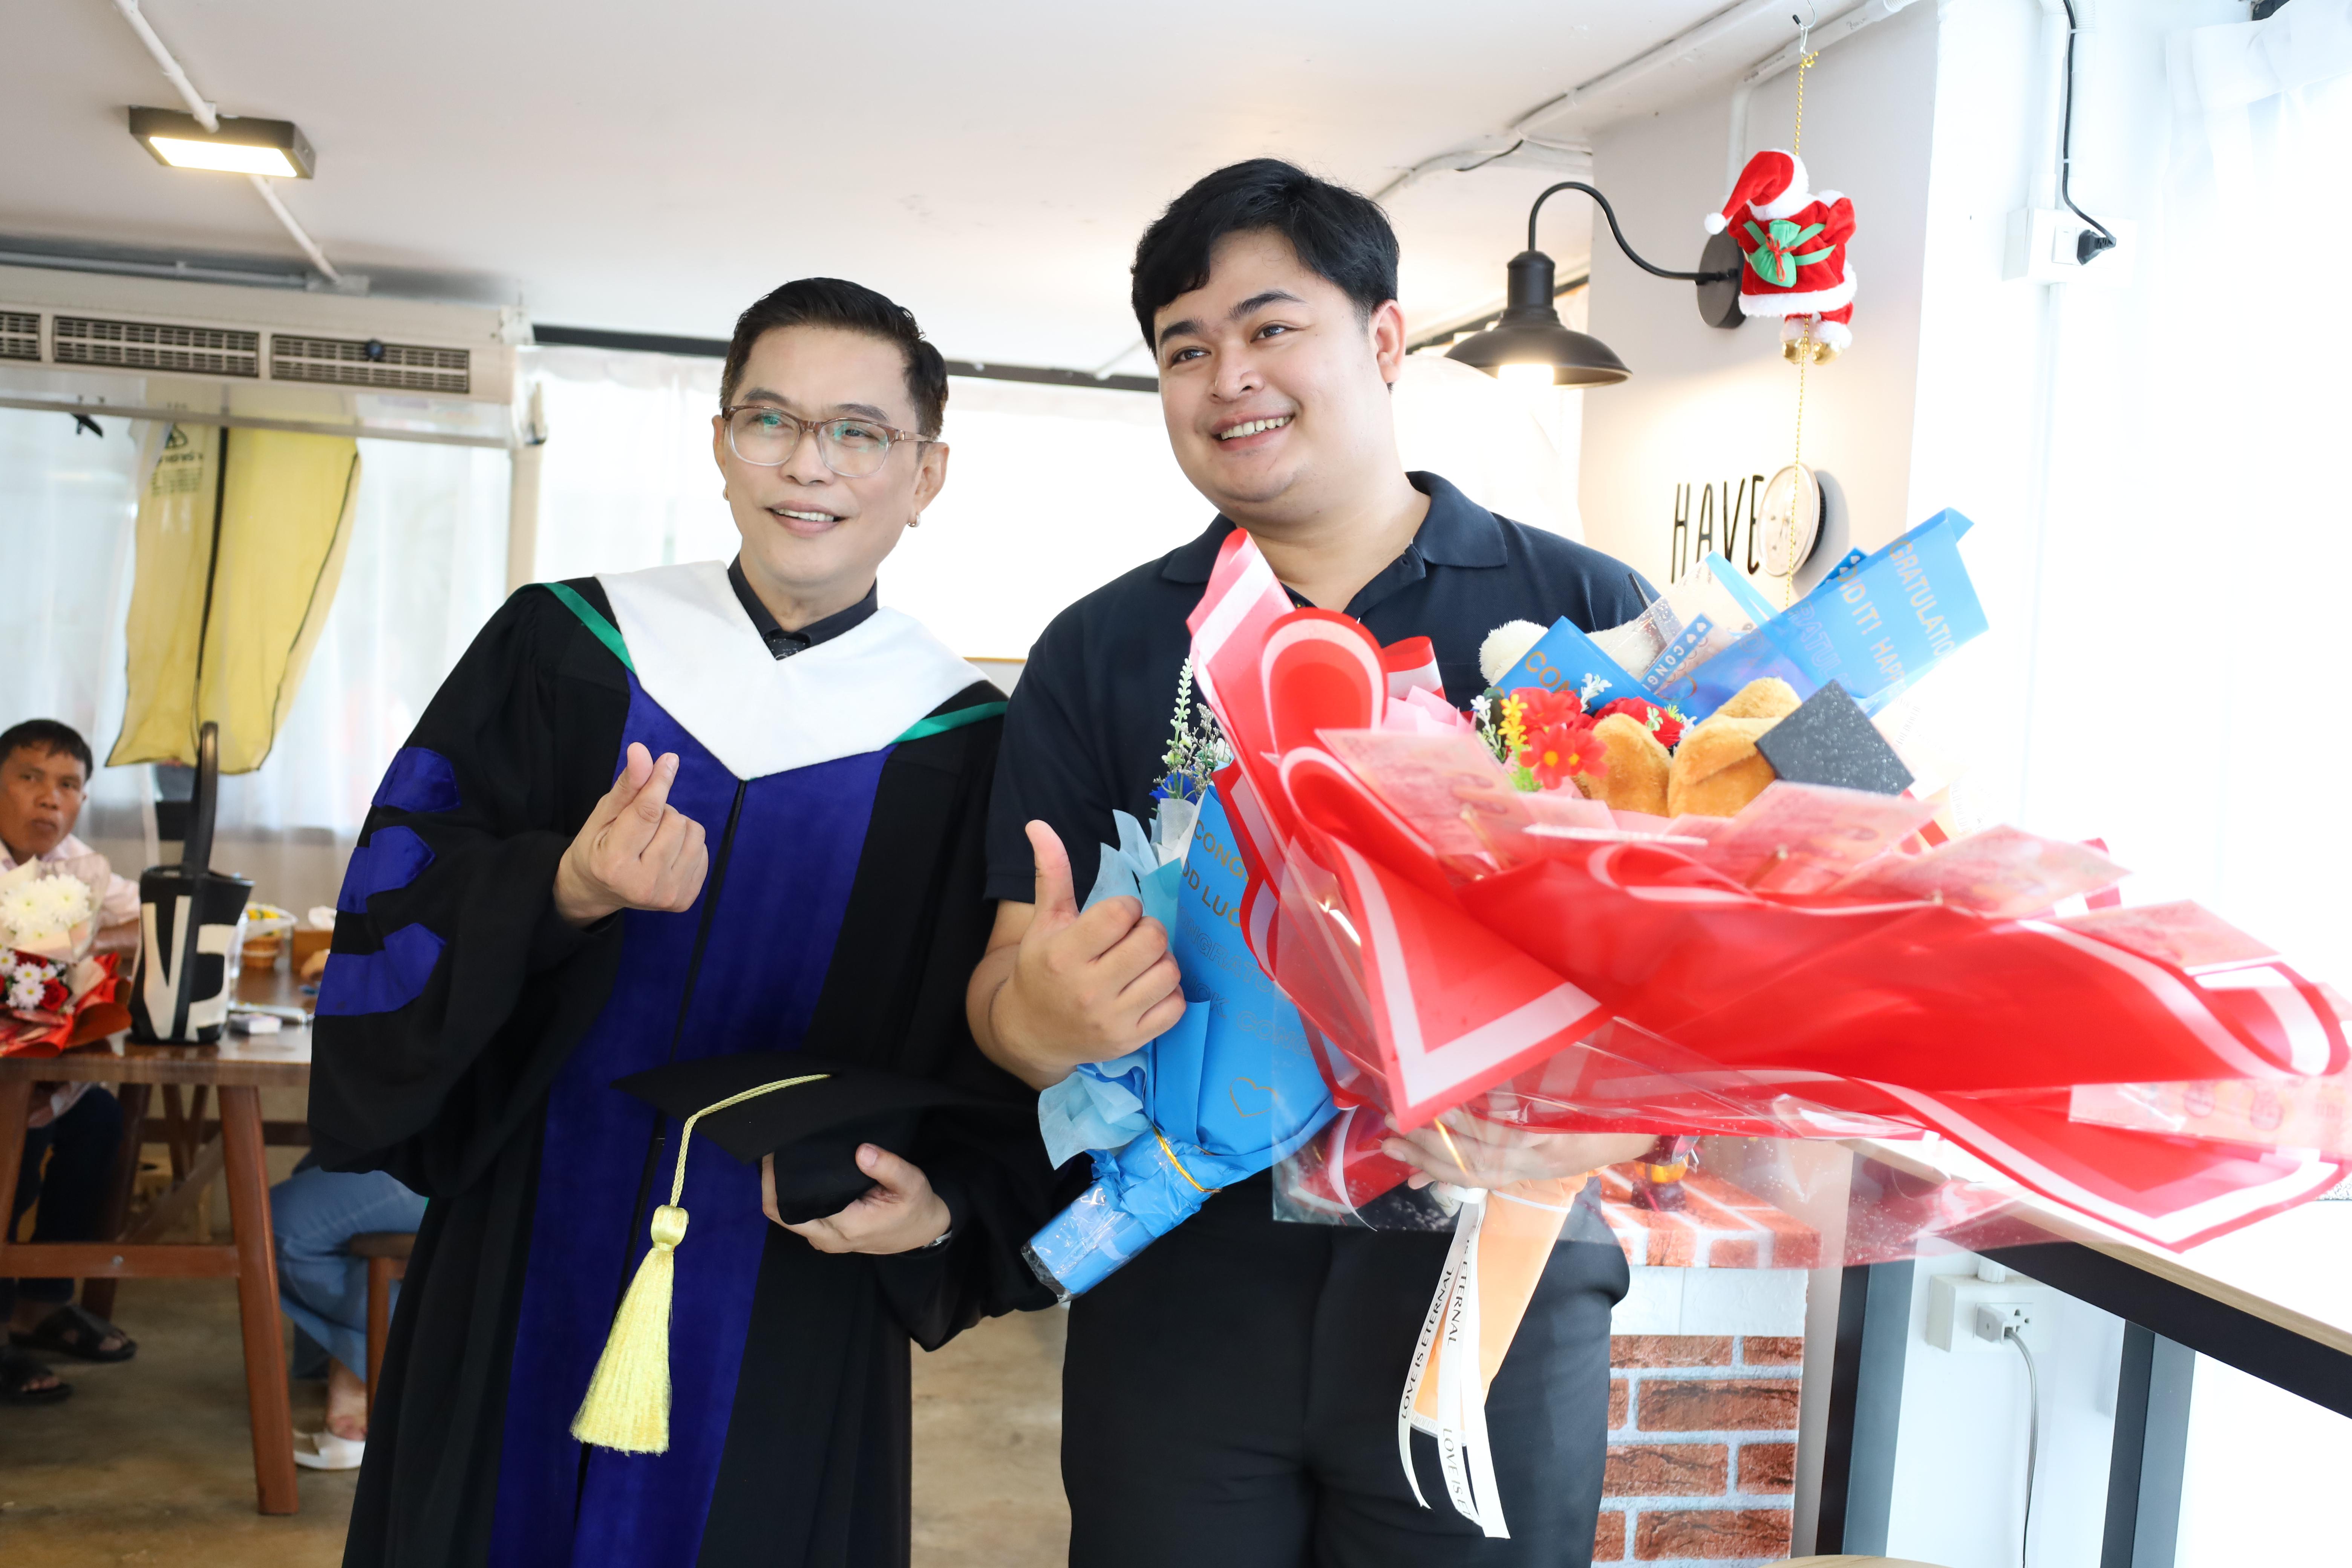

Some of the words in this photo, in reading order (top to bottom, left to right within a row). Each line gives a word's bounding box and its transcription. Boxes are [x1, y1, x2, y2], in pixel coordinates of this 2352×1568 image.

[1671, 475, 1764, 585] HAVE
[1853, 602, 1882, 635] IT!
[1642, 645, 1685, 691] CONG
[1194, 819, 1250, 883] CONG
[1237, 1010, 1313, 1060] CONG
[1448, 1261, 1467, 1346] ETERNAL
[1402, 1371, 1417, 1419] LOVE
[1415, 1352, 1424, 1367] IS
[1421, 1267, 1454, 1347] ETERNAL
[1443, 1428, 1459, 1476] LOVE
[1452, 1479, 1463, 1495] IS
